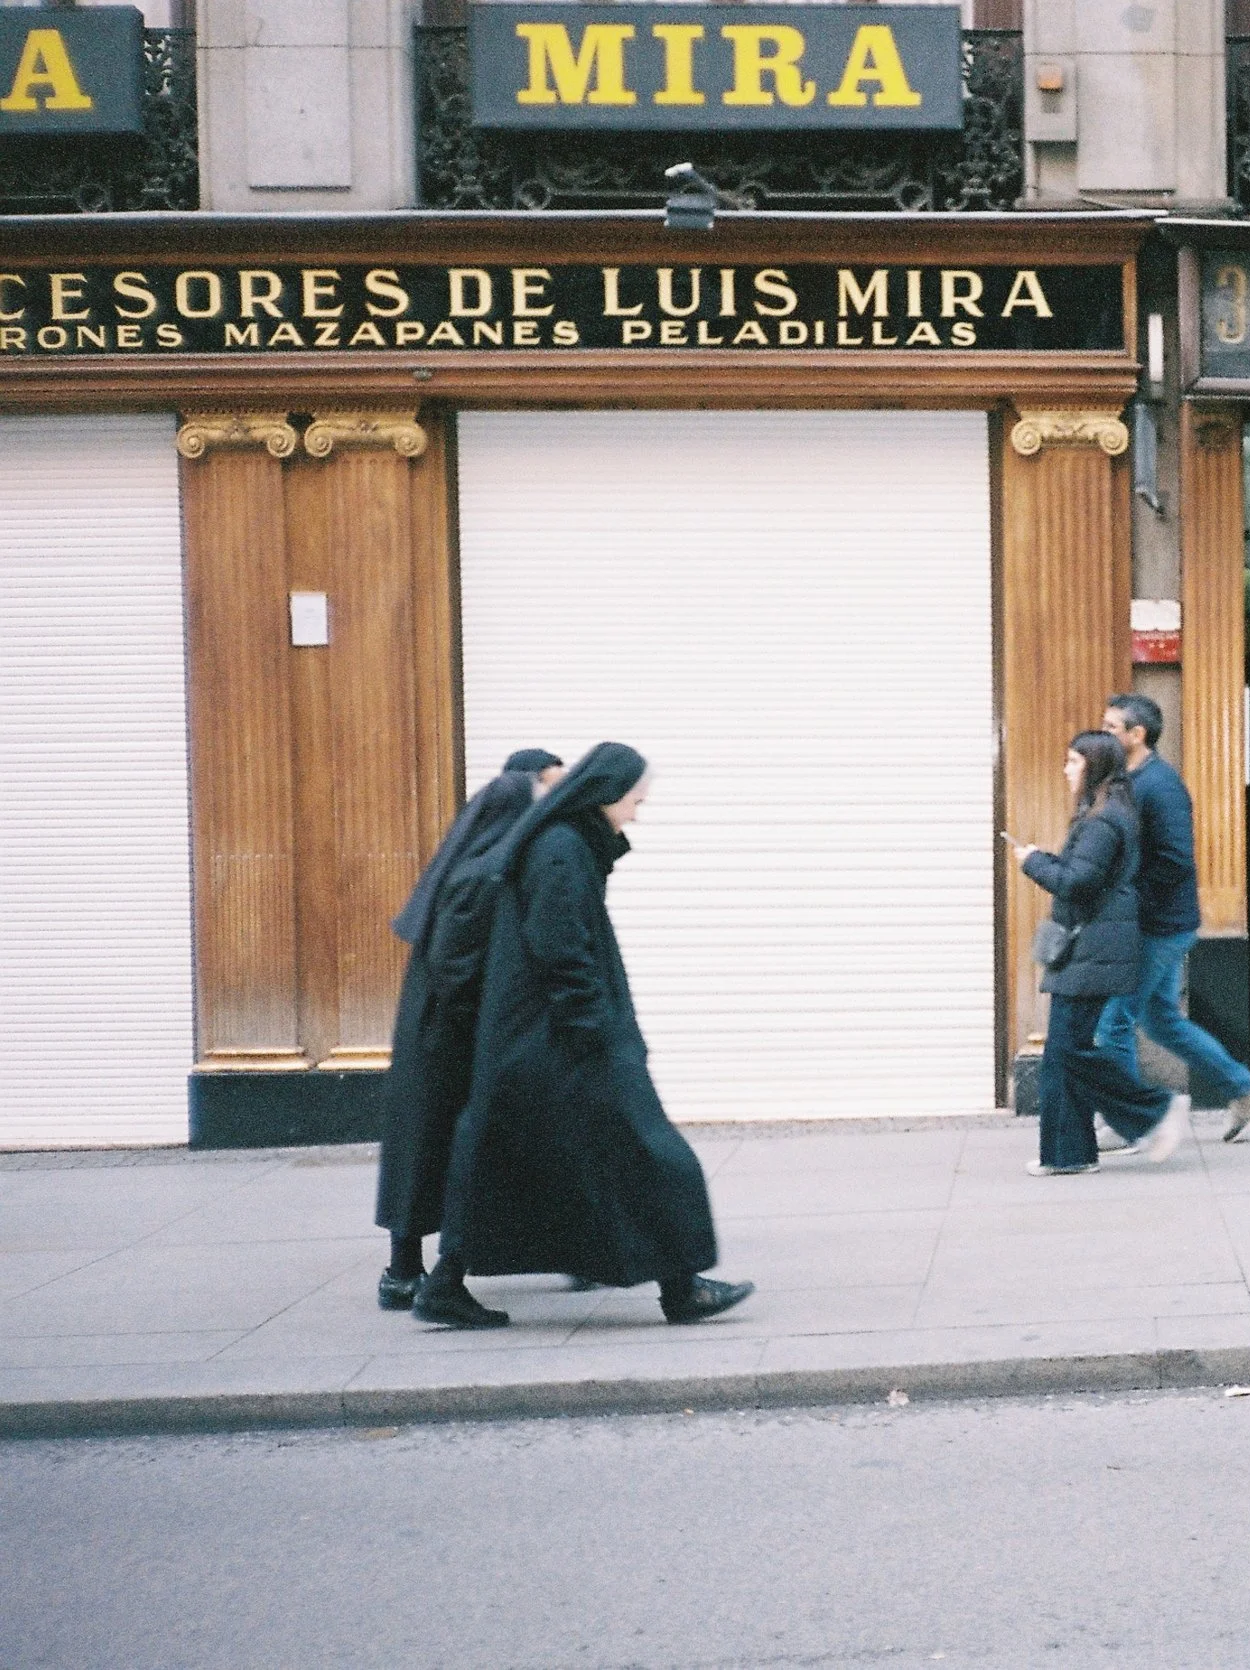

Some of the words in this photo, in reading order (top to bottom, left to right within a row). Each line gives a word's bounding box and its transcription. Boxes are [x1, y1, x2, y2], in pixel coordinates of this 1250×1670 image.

[517, 23, 922, 107] MIRA
[448, 268, 555, 317] DE
[602, 268, 799, 317] LUIS
[838, 269, 1053, 318] MIRA
[223, 320, 580, 348] MAZAPANES
[621, 320, 978, 347] PELADILLAS
